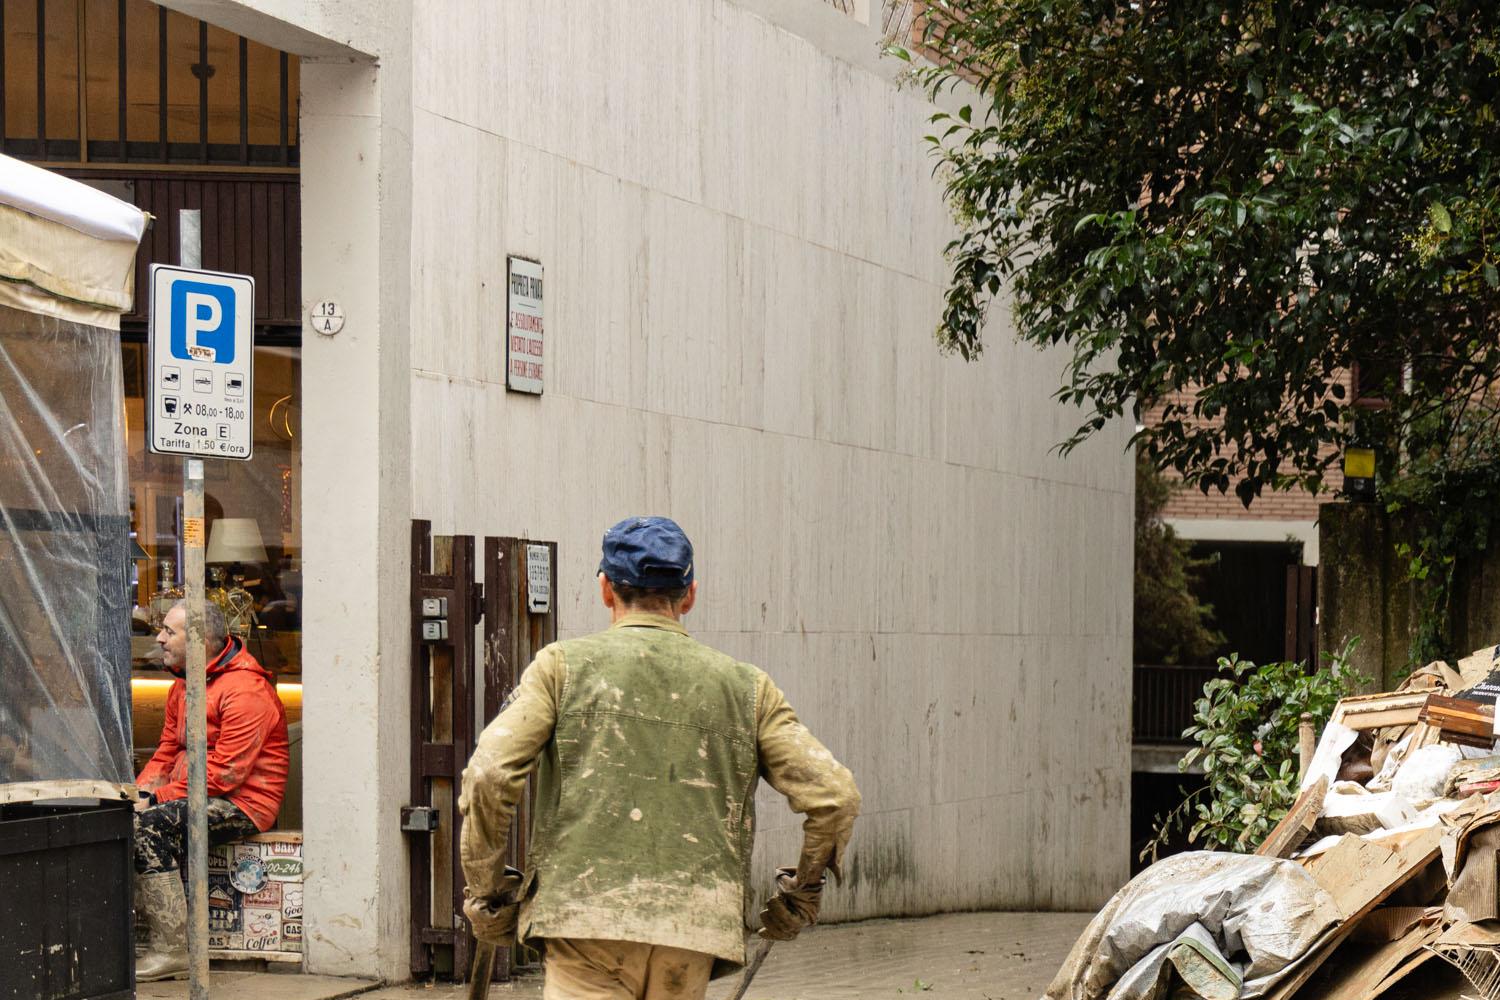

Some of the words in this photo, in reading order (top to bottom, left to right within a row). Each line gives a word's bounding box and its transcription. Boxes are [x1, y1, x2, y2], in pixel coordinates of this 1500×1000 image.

[321, 302, 335, 315] 13
[185, 291, 223, 352] P
[323, 318, 332, 330] A
[174, 422, 208, 437] Zona
[219, 426, 228, 438] E
[160, 437, 191, 449] Tariffa
[220, 443, 245, 454] €/ora
[246, 936, 279, 950] Coffee
